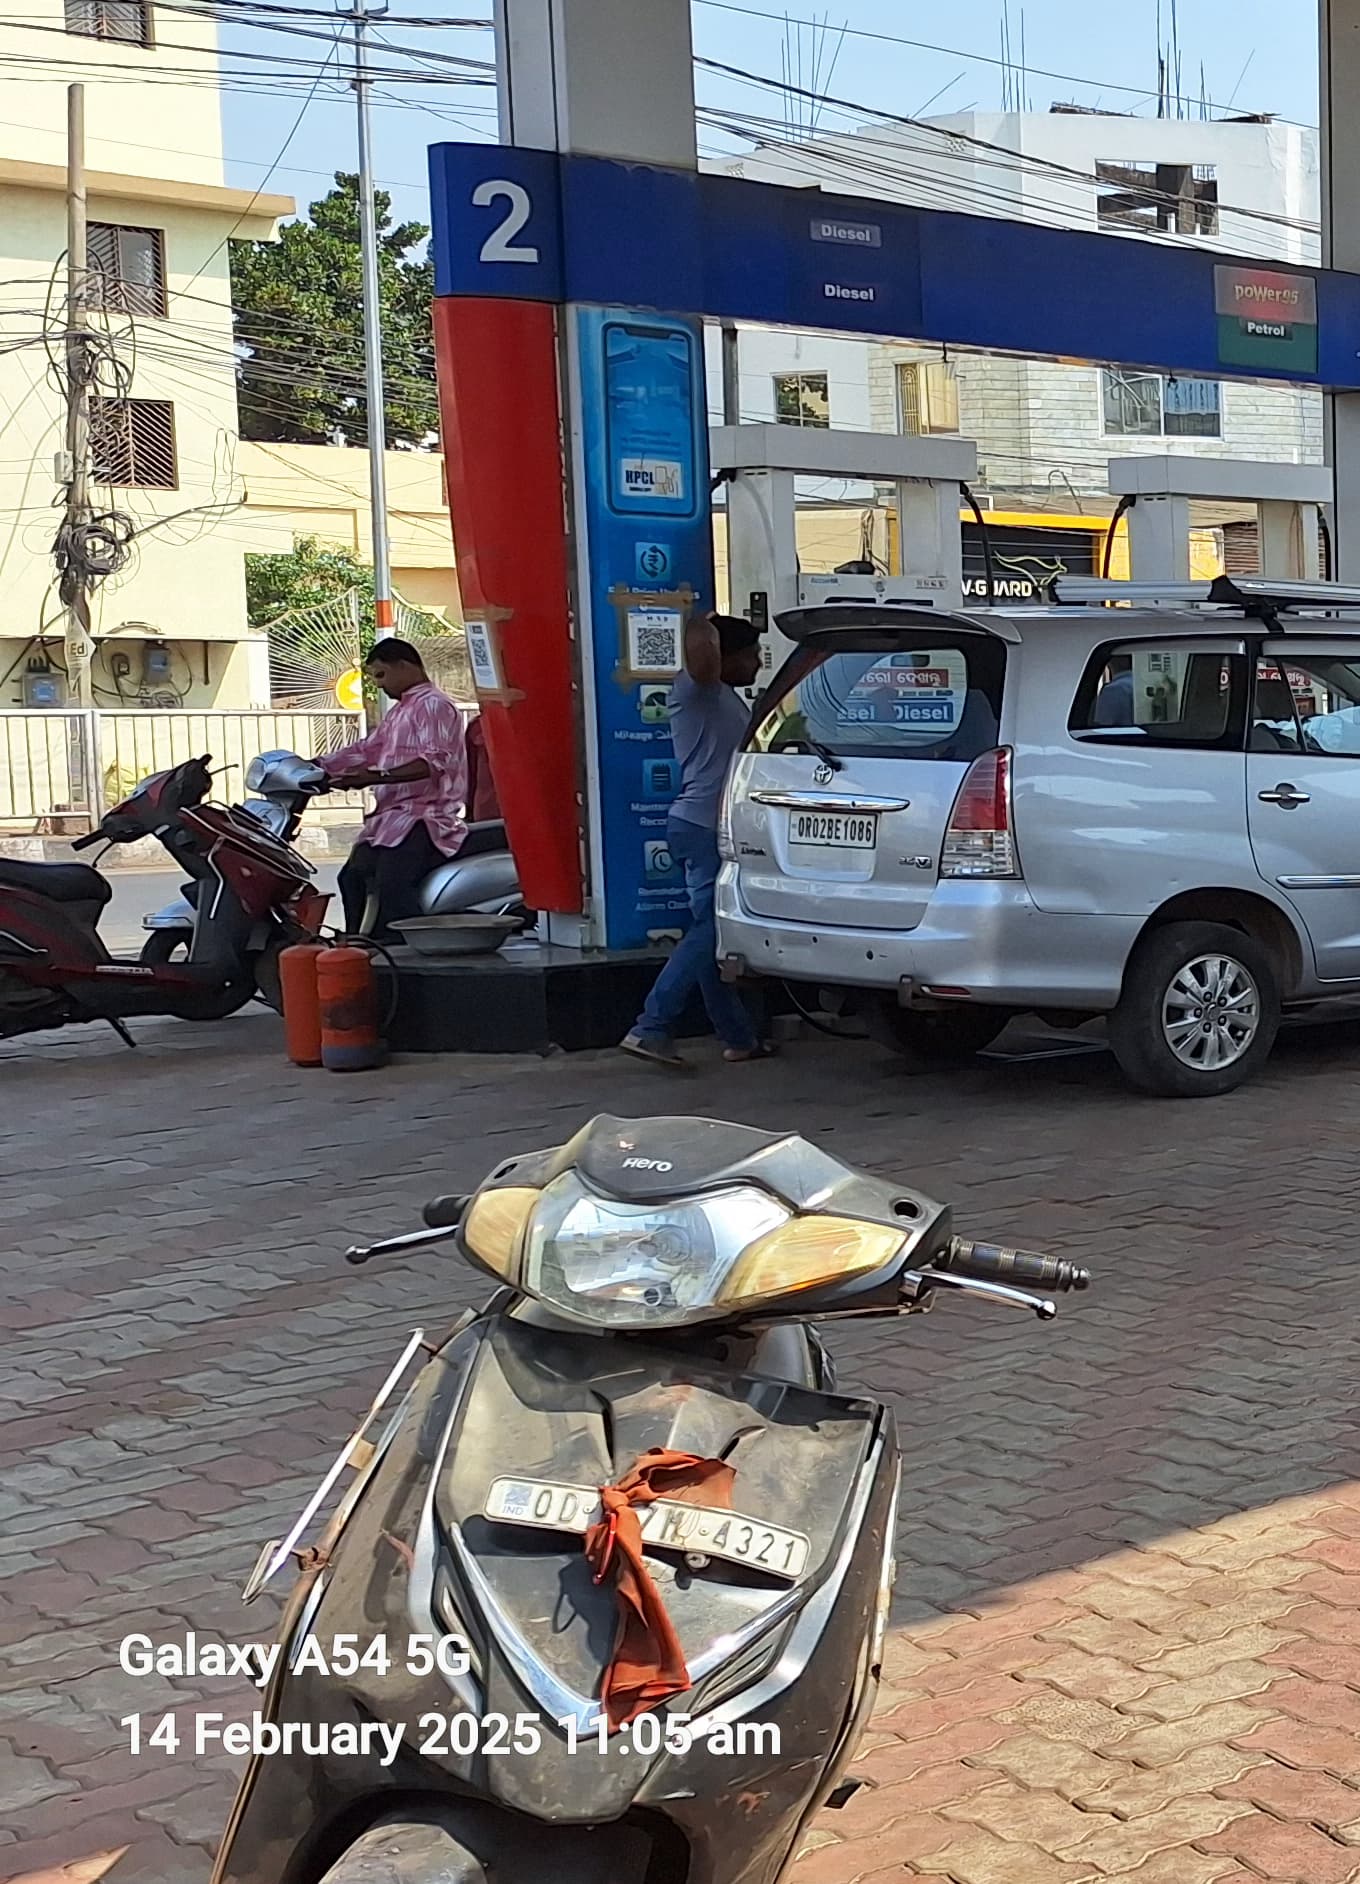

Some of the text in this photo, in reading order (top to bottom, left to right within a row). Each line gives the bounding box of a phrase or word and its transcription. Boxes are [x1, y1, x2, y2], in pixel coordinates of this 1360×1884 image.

[471, 180, 539, 264] 2
[821, 224, 870, 241] Diesel
[824, 284, 874, 300] Diesel
[1247, 321, 1285, 337] Petrol
[625, 470, 655, 485] HPCL
[798, 816, 873, 842] OR02BE1086
[622, 1157, 673, 1172] Hero
[501, 1505, 525, 1516] IND
